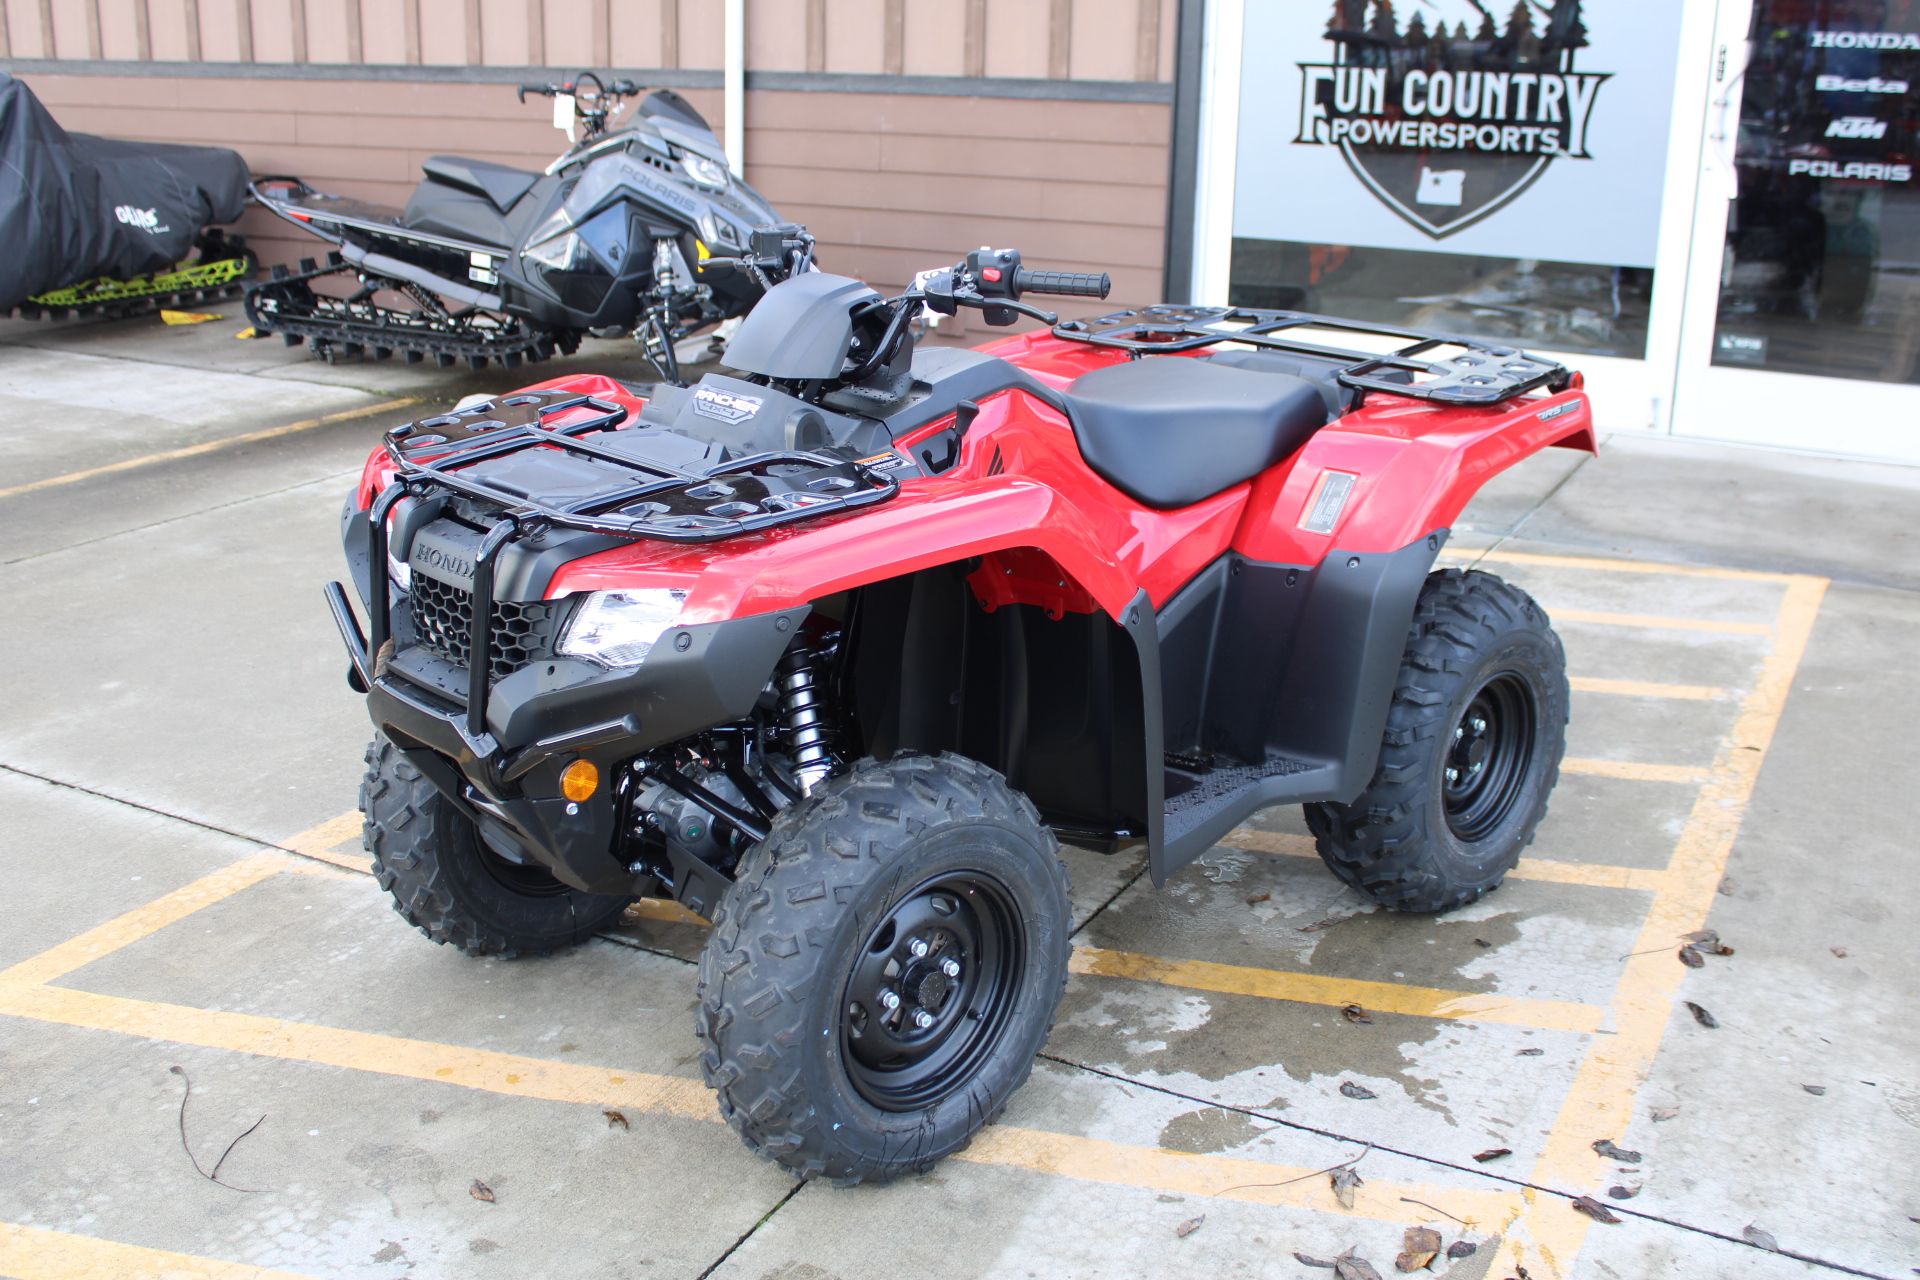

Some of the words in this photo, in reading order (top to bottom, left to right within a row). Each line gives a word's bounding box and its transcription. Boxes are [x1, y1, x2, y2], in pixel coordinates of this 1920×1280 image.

[1811, 31, 1920, 50] HONDA
[1815, 74, 1909, 94] Beta
[1301, 66, 1387, 142] FUN
[1403, 69, 1600, 156] COUNTRY
[1331, 117, 1560, 154] POWERSPORTS
[1824, 116, 1888, 139] KTM
[1788, 159, 1912, 181] POLARIS
[620, 164, 697, 212] POLARIS
[694, 389, 761, 415] RANCHER
